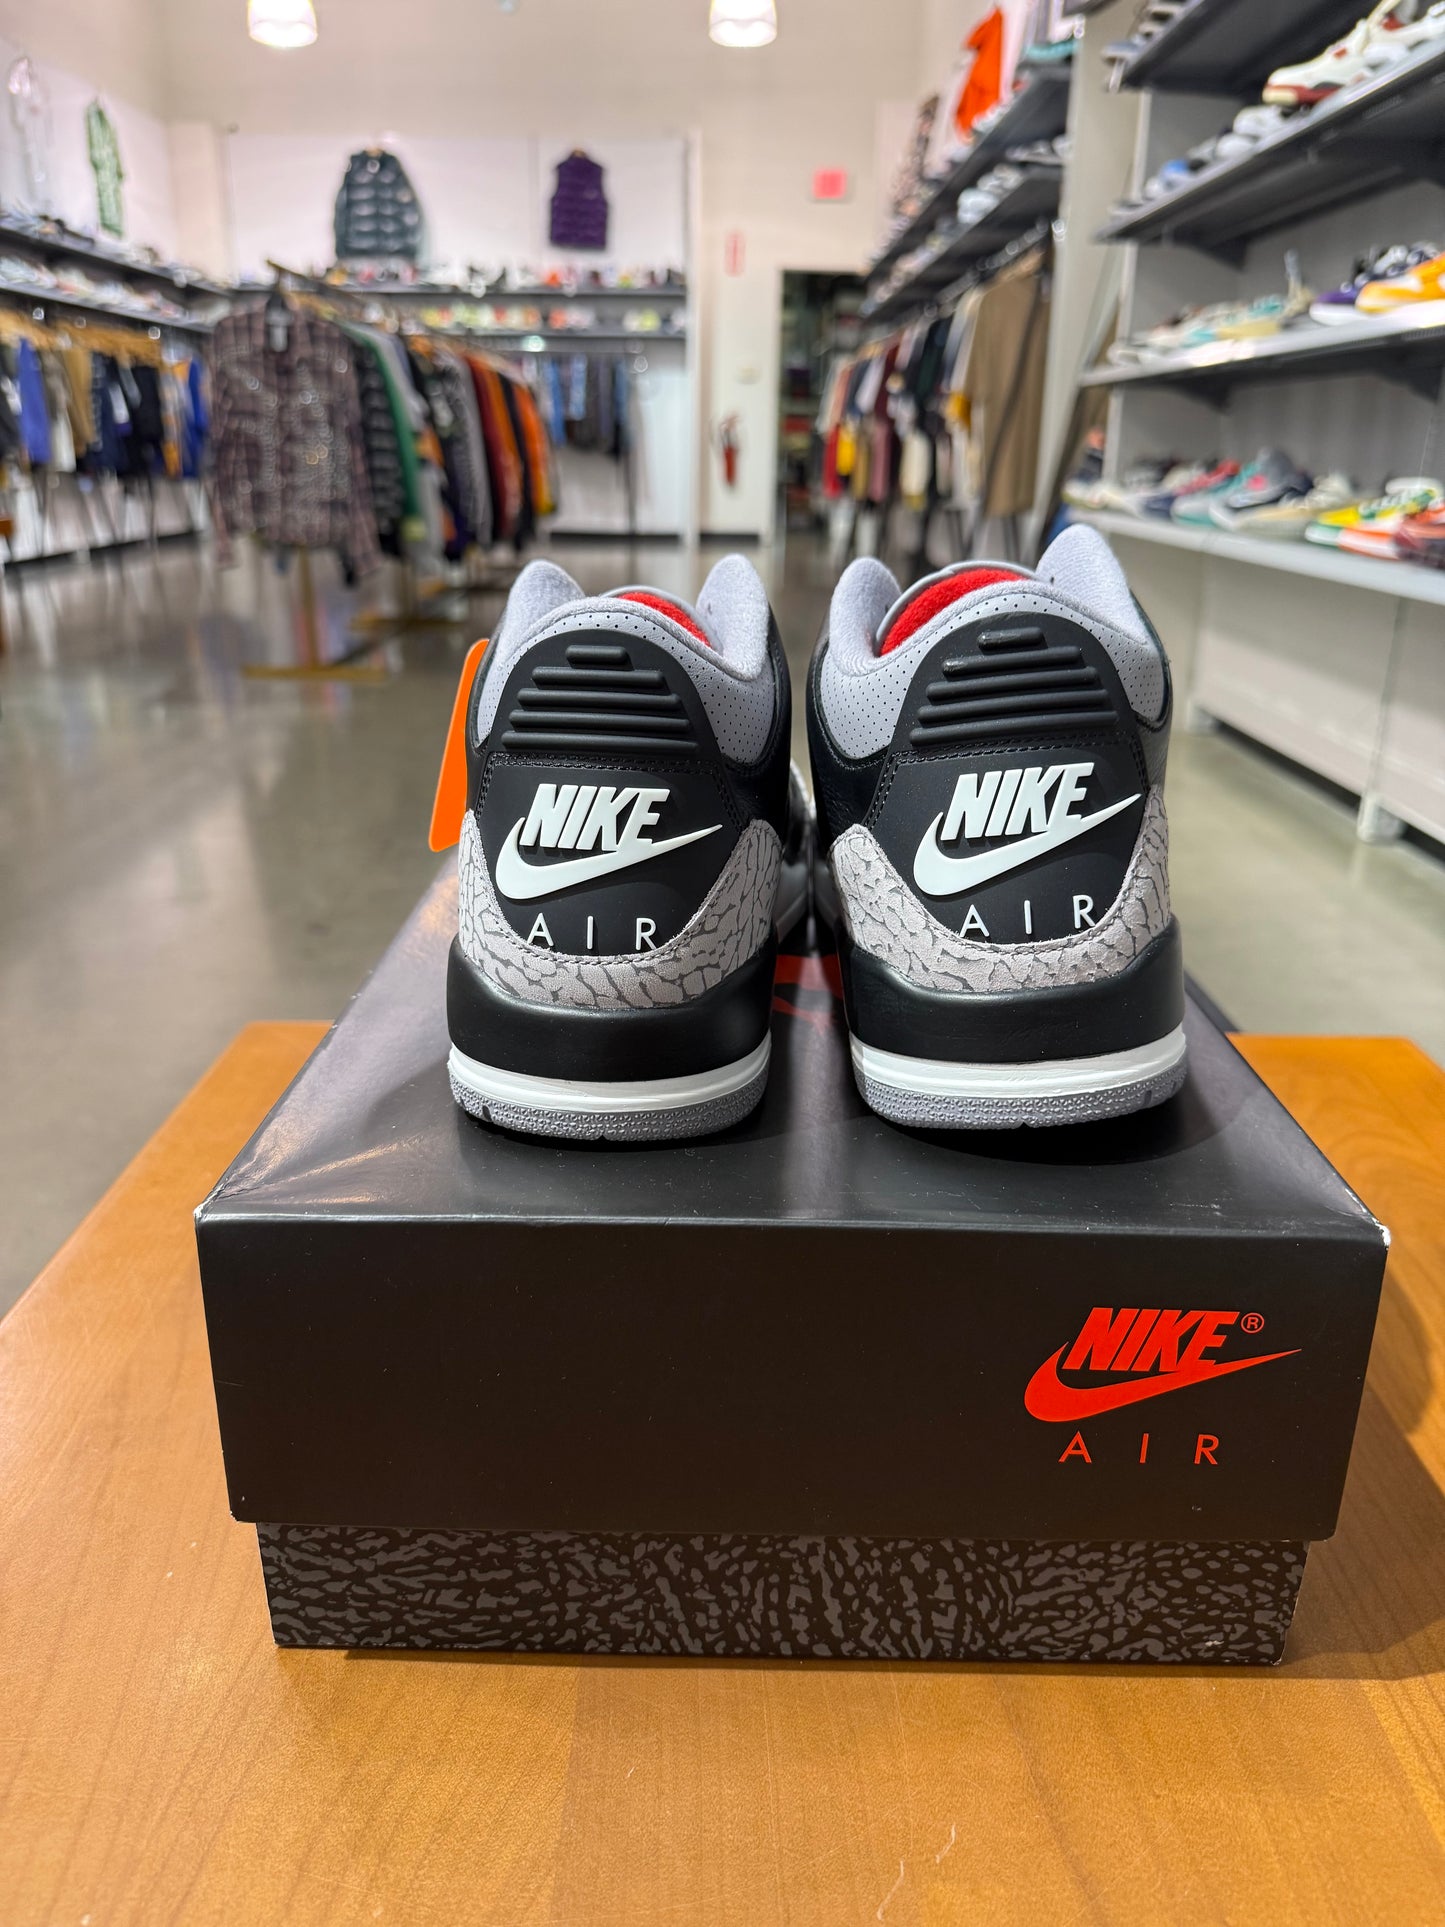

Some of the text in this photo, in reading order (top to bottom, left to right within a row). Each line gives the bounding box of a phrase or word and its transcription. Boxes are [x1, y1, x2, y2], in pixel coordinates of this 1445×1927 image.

[519, 783, 671, 852] NIKE
[940, 762, 1095, 842] NIKE
[527, 911, 657, 951] AIR
[960, 893, 1097, 938] AIR
[1058, 1430, 1220, 1465] AIR
